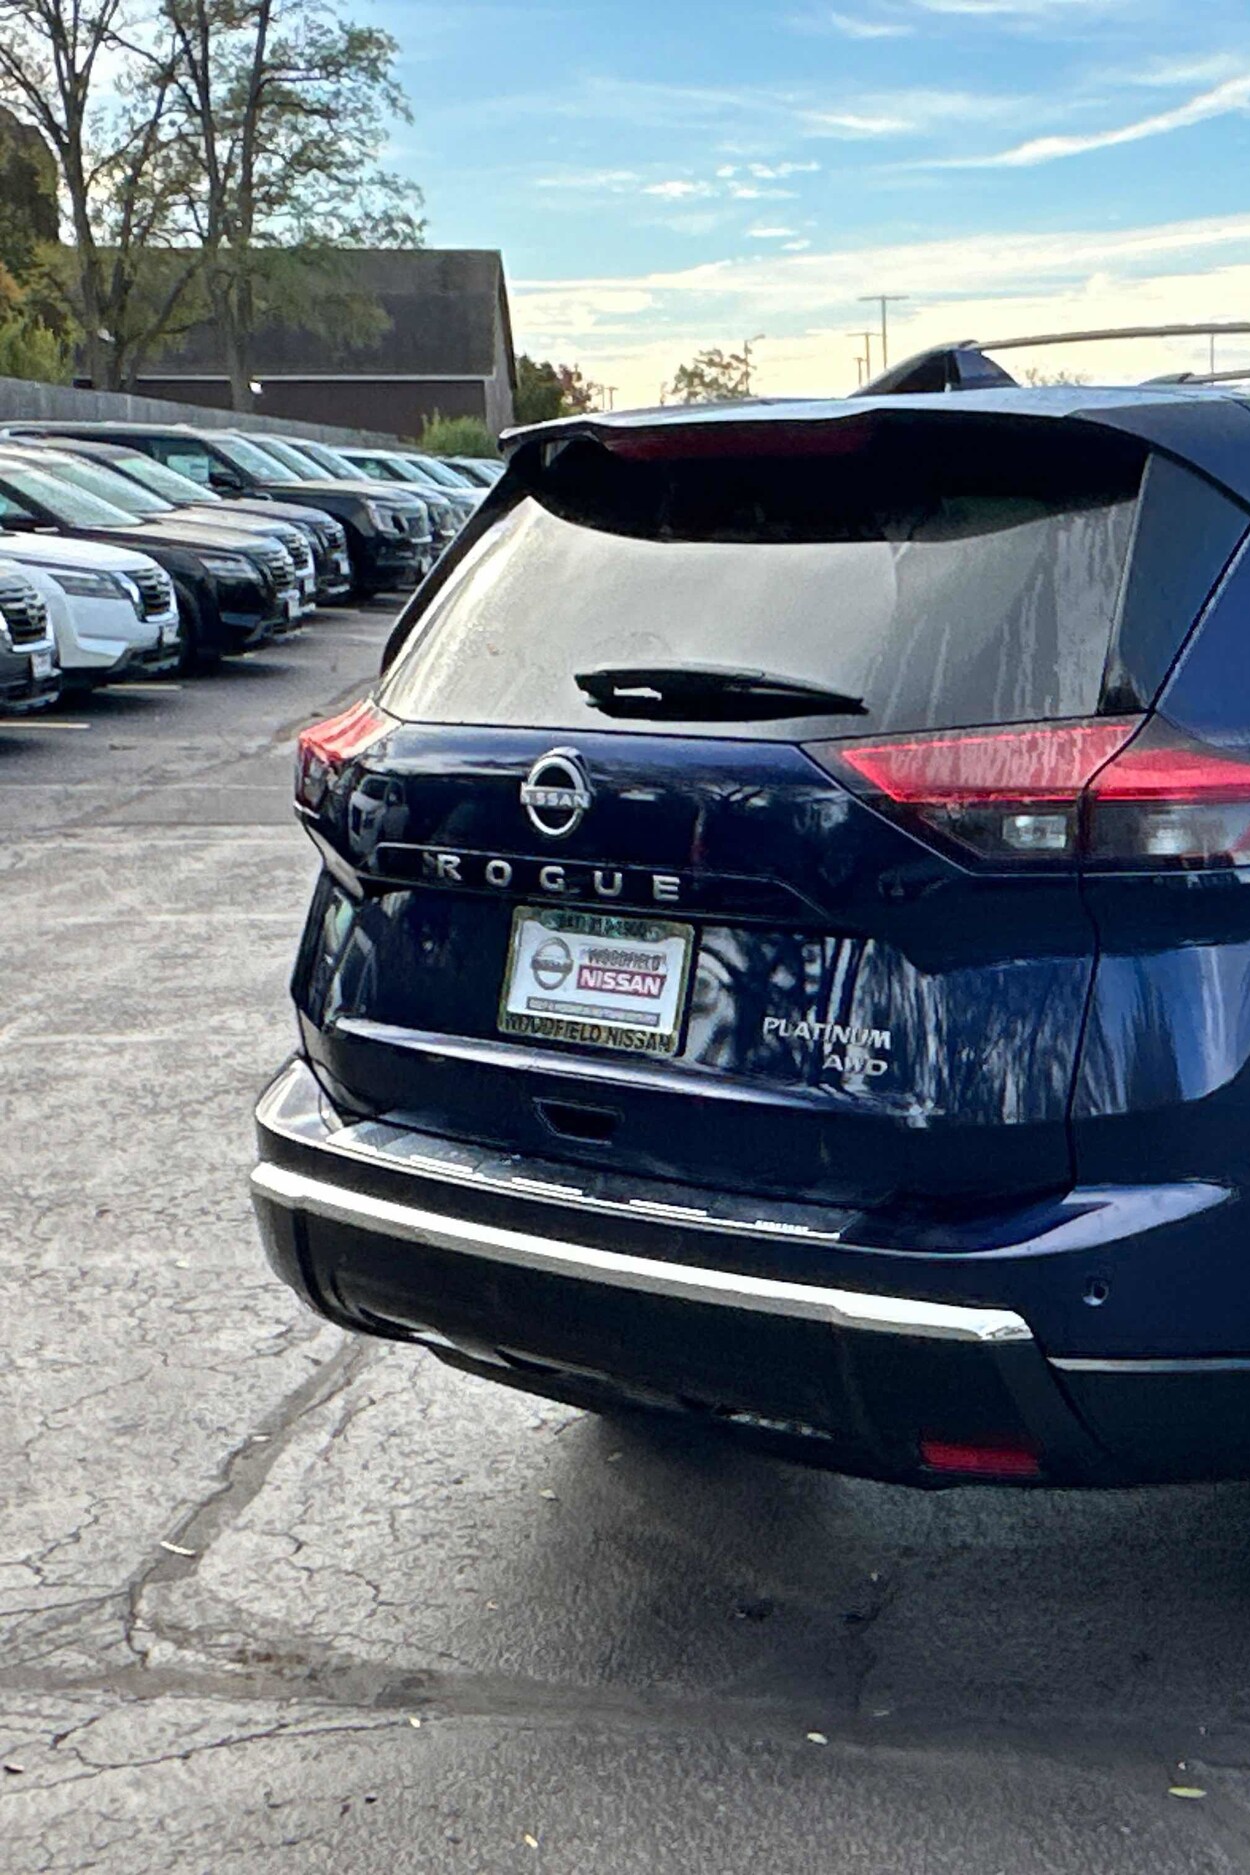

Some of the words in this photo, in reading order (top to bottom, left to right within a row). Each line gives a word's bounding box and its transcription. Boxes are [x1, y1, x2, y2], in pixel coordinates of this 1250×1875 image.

[436, 853, 681, 900] ROGUE
[580, 969, 662, 996] NISSAN
[606, 1027, 672, 1053] NISSAN
[763, 1016, 892, 1050] PLATINUM
[822, 1054, 888, 1076] AWD
